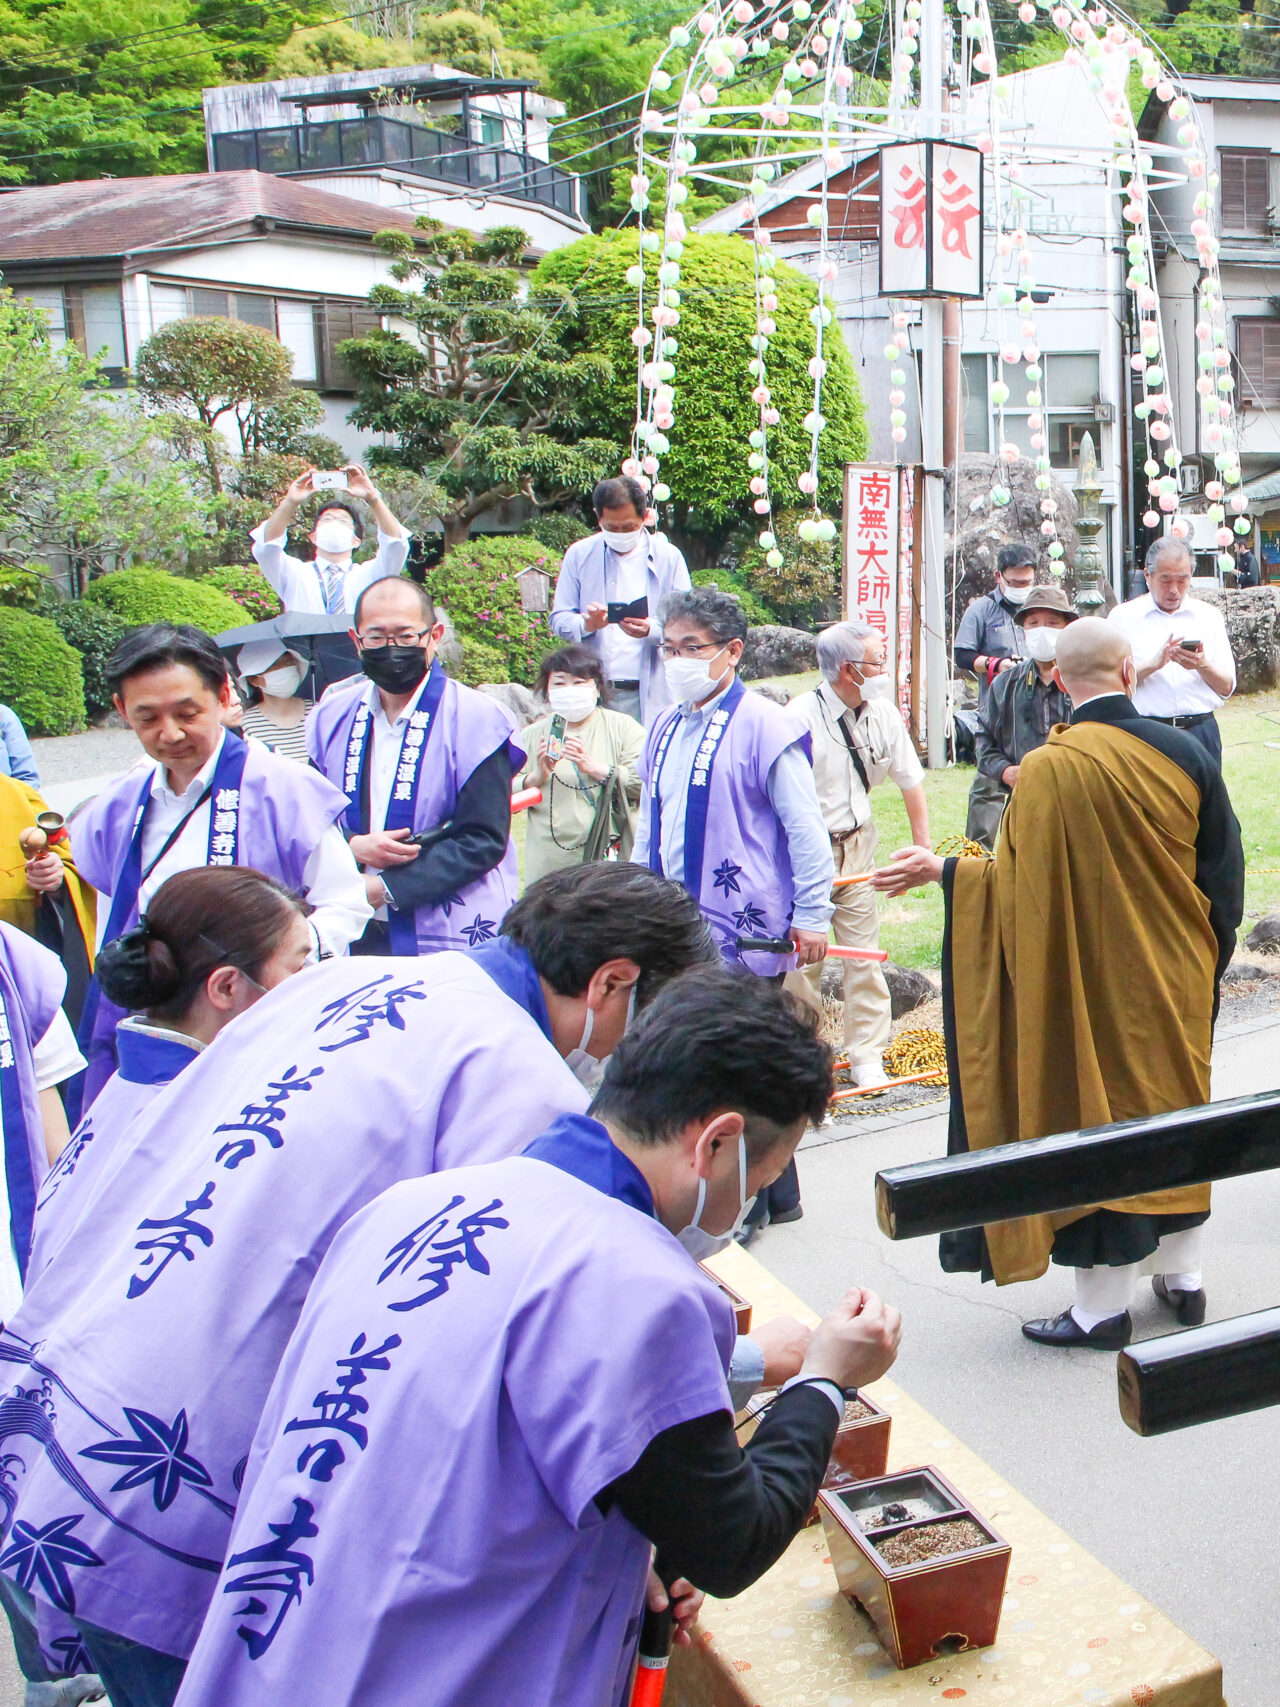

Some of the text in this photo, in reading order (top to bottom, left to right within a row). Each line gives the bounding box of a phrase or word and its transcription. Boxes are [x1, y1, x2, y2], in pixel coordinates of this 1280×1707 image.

[393, 709, 430, 801] 修善寺温泉
[691, 708, 730, 787] 修善寺温泉
[126, 974, 428, 1300] 修善寺
[223, 1195, 511, 1661] 修善寺
